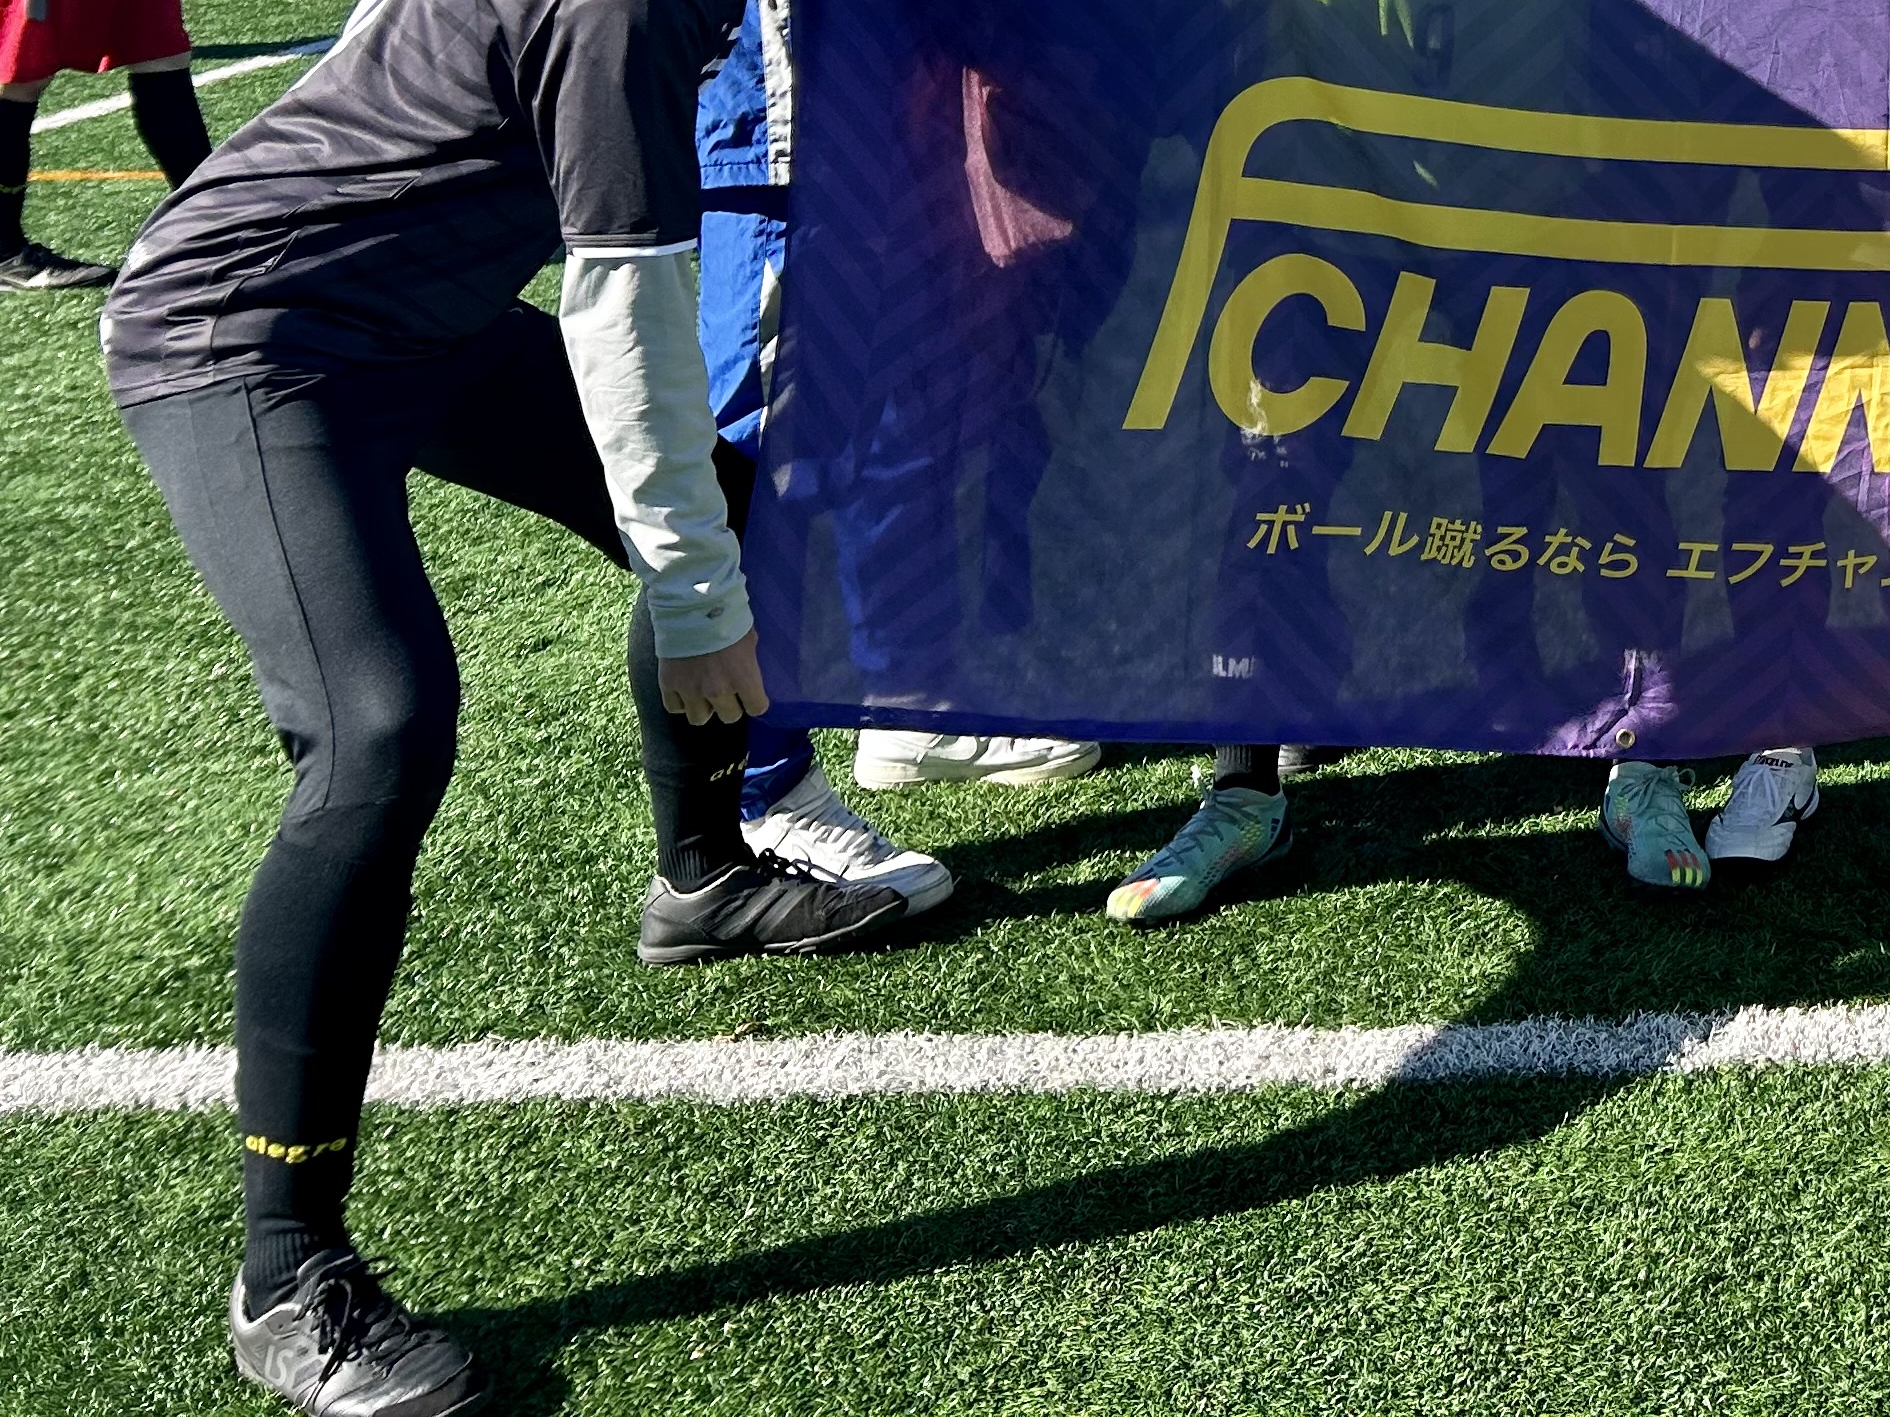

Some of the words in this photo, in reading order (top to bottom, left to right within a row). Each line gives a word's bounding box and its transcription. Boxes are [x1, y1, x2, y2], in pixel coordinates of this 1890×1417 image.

[1246, 502, 1640, 578] ボール蹴るなら
